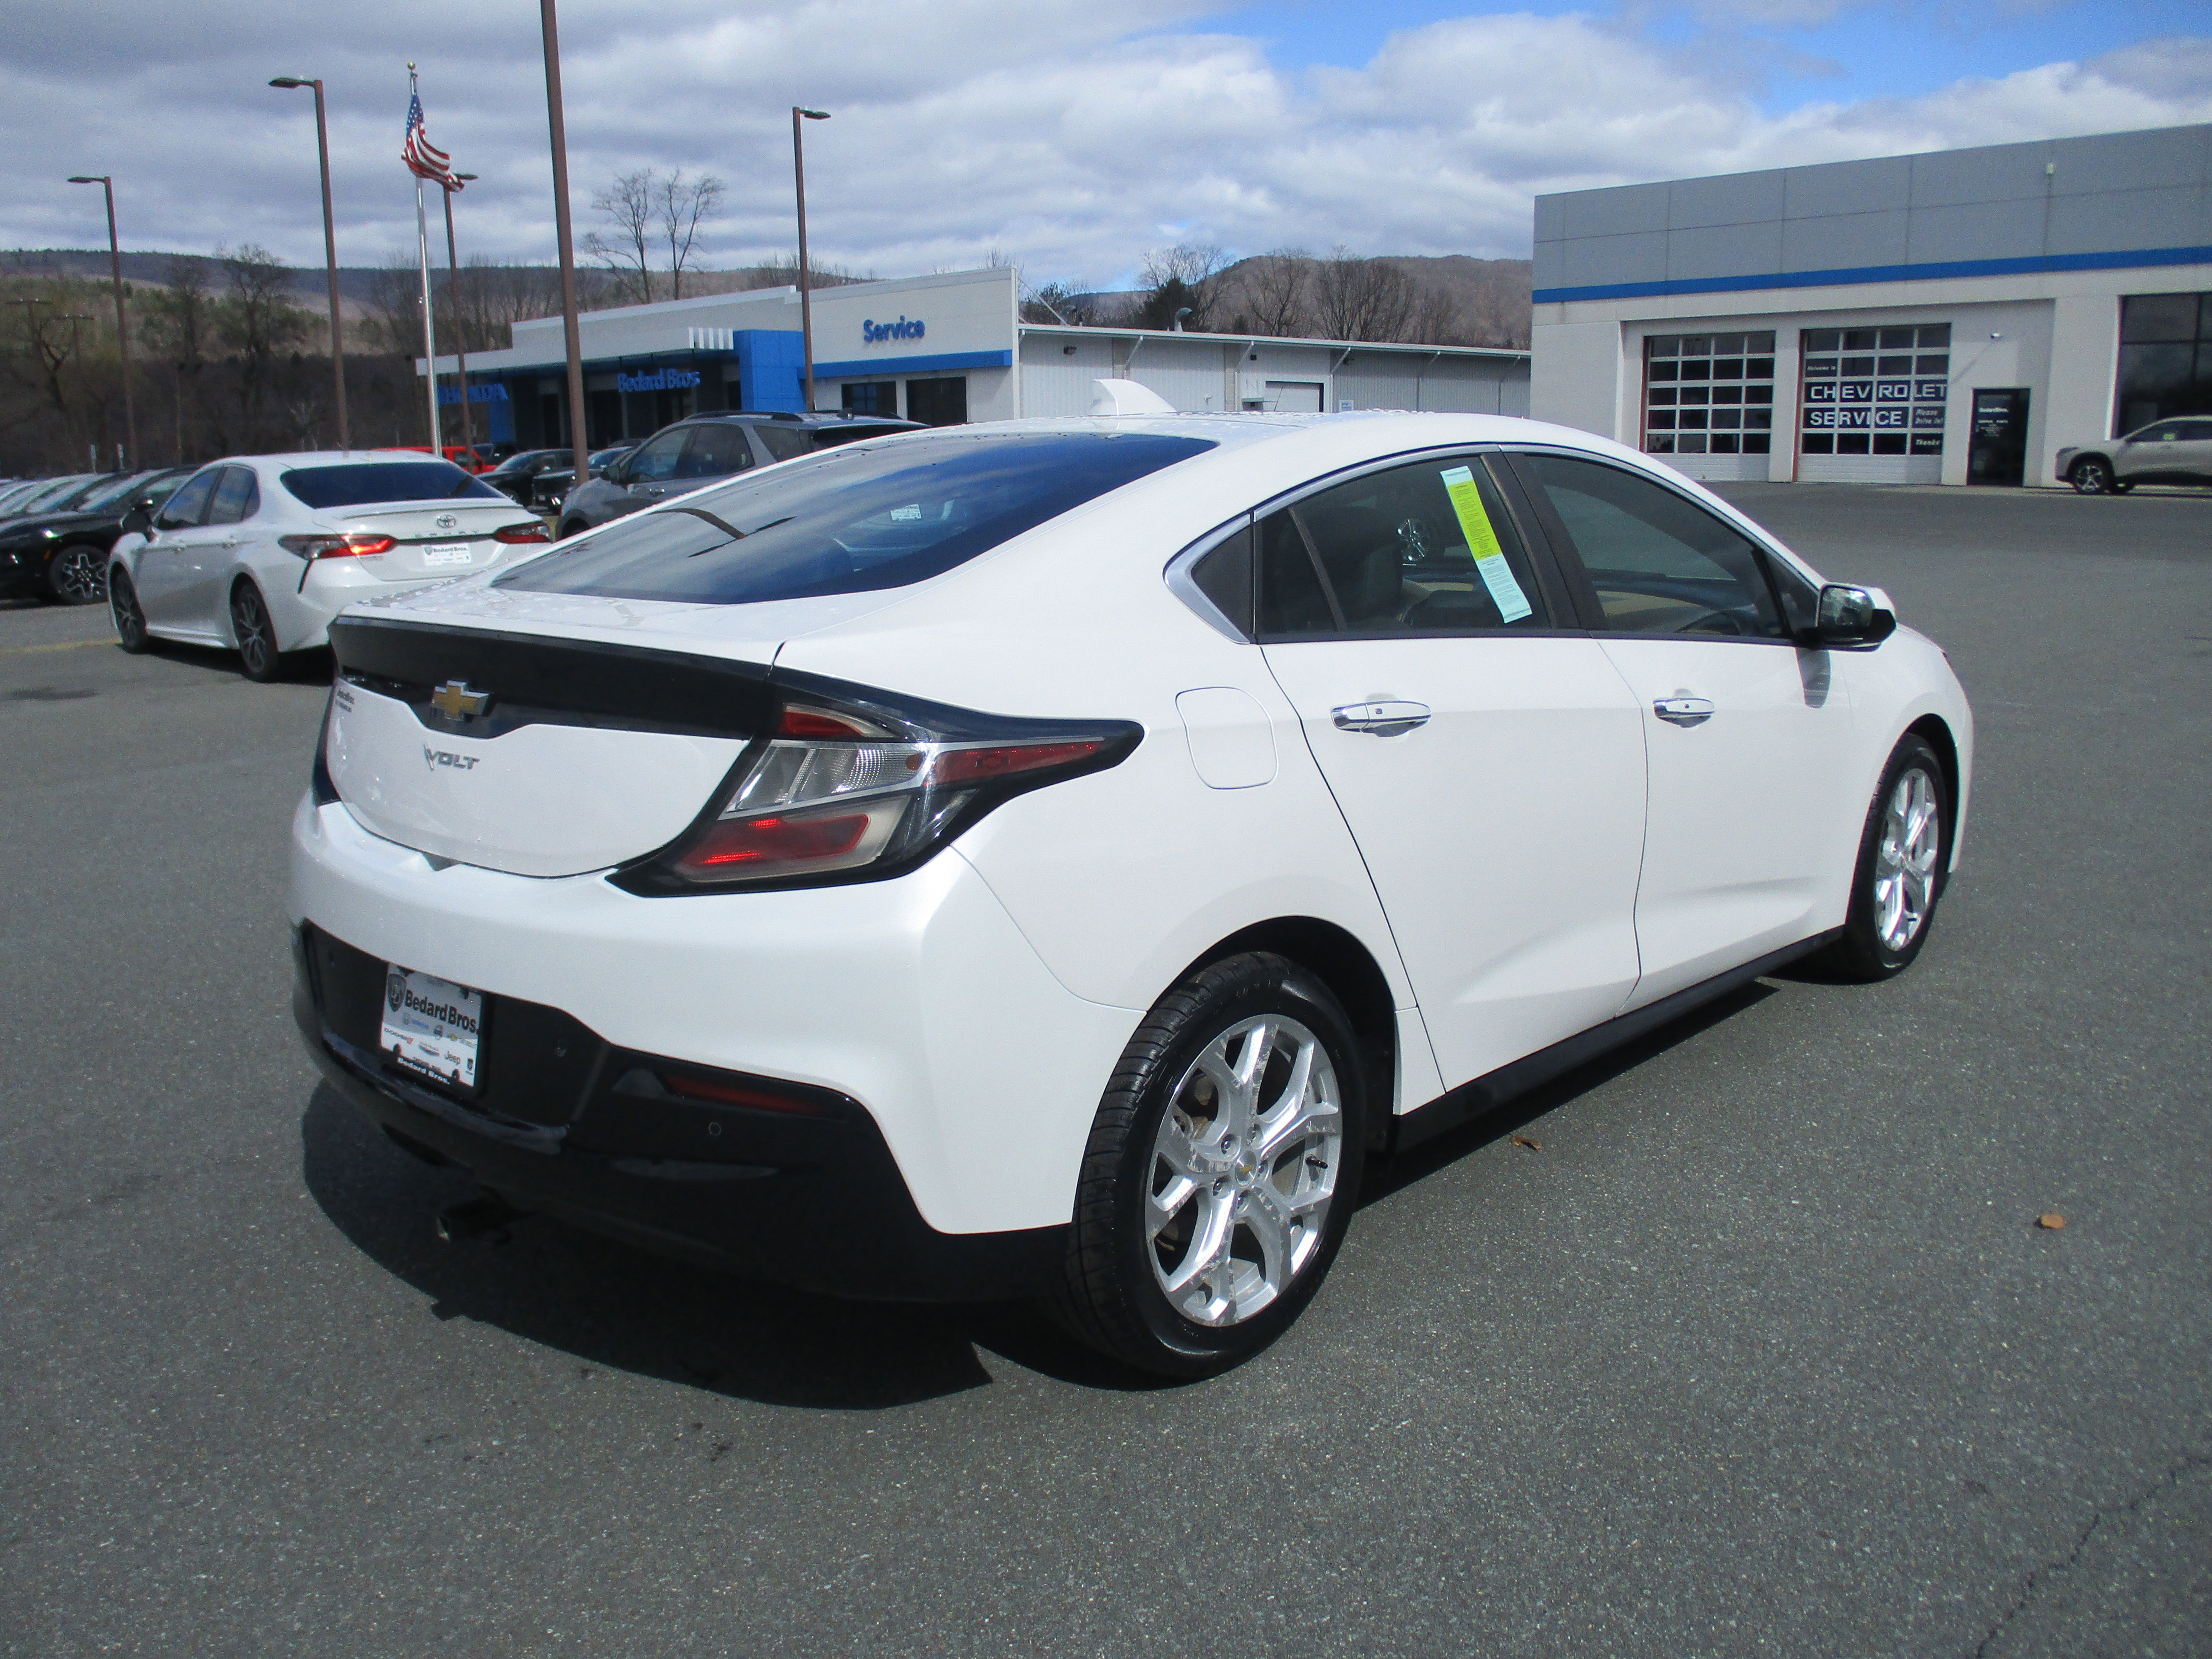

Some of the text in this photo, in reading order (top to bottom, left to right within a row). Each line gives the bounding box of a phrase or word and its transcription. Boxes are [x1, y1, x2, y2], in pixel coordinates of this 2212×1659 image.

[863, 315, 925, 342] Service
[618, 368, 666, 392] Bedard
[1811, 384, 1947, 399] CHEVROLET
[1810, 411, 1902, 425] SERVICE
[423, 744, 480, 771] VOLT
[405, 989, 448, 1022] Bedard
[445, 1050, 461, 1066] Jeep
